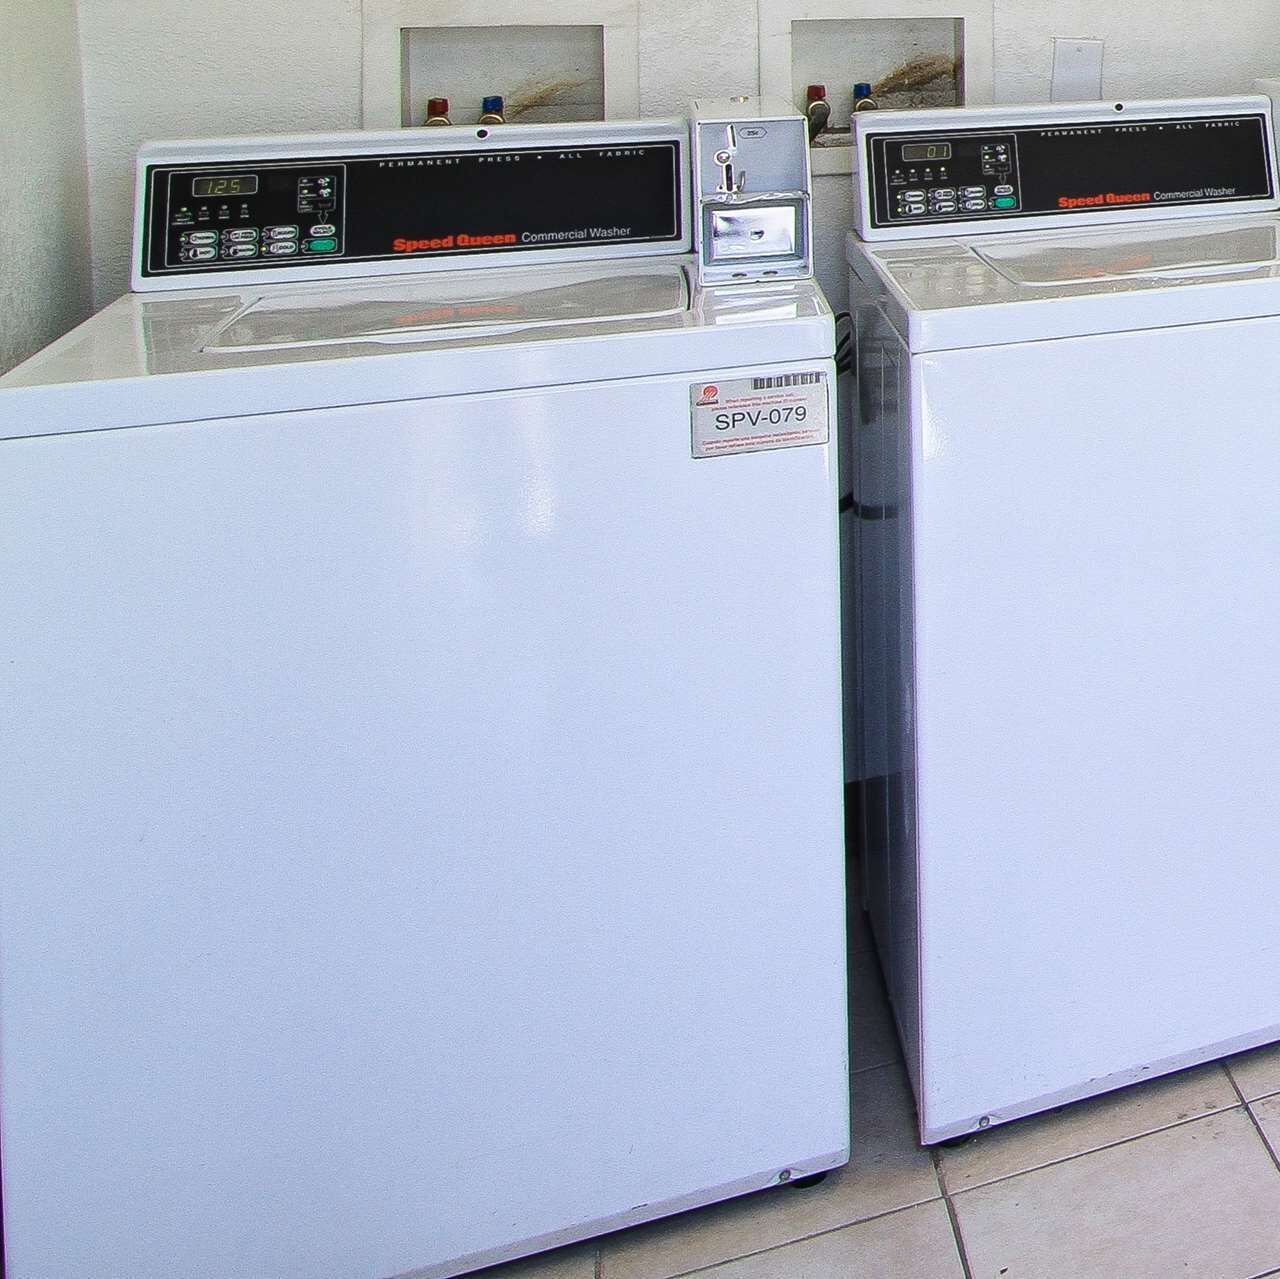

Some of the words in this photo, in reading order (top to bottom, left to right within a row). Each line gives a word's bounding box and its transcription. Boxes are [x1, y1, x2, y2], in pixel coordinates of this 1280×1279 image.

[1040, 128, 1102, 137] PERMANENT
[379, 158, 460, 168] PERMANENT
[478, 155, 520, 163] PRESS
[599, 149, 645, 157] FABRIC
[207, 179, 241, 194] 125
[1058, 194, 1104, 208] Speed
[1106, 192, 1150, 203] Queen
[1153, 190, 1203, 201] Commercial
[1204, 187, 1236, 197] Washer
[392, 235, 453, 253] Speed
[456, 232, 516, 247] Queen
[521, 228, 587, 243] Commercial
[589, 226, 631, 239] Washer
[715, 405, 807, 431] SPV-079
